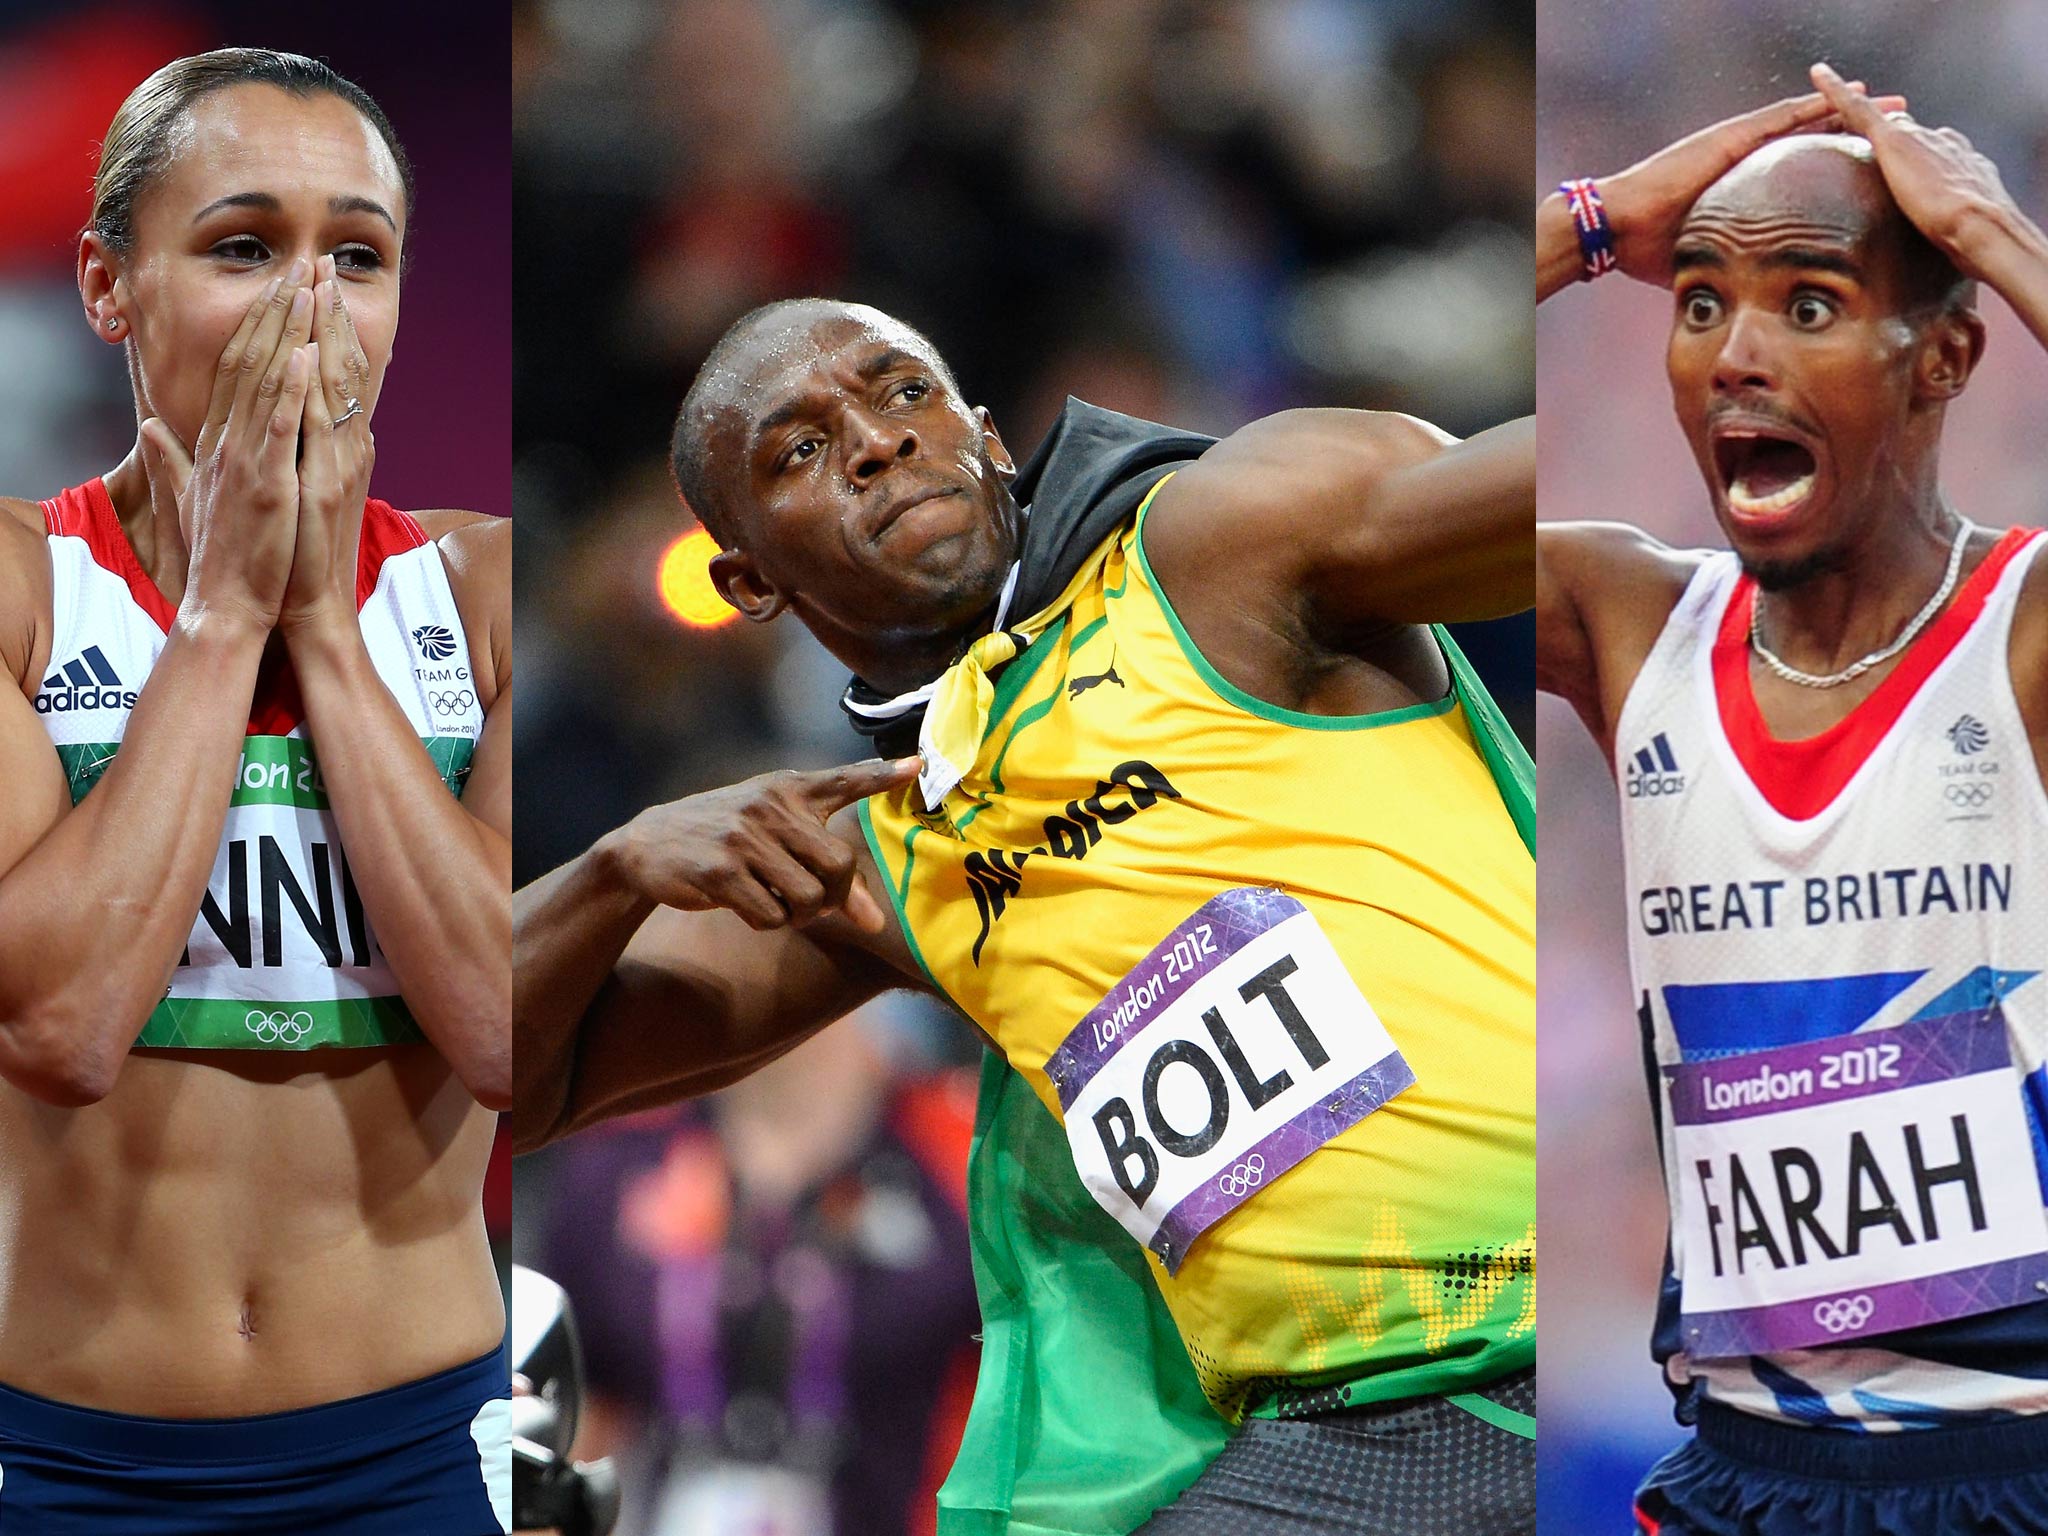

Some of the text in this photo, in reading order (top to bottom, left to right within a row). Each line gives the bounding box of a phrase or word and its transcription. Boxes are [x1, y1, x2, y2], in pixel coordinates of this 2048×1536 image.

[34, 686, 138, 714] adidas
[415, 667, 469, 682] TEAM G
[436, 724, 460, 733] London
[1640, 864, 2012, 936] GREAT BRITAIN
[1092, 923, 1217, 1052] London 2012
[1092, 953, 1331, 1211] BOLT
[1703, 1043, 1901, 1111] London 2012
[1695, 1113, 1988, 1277] FARAH
